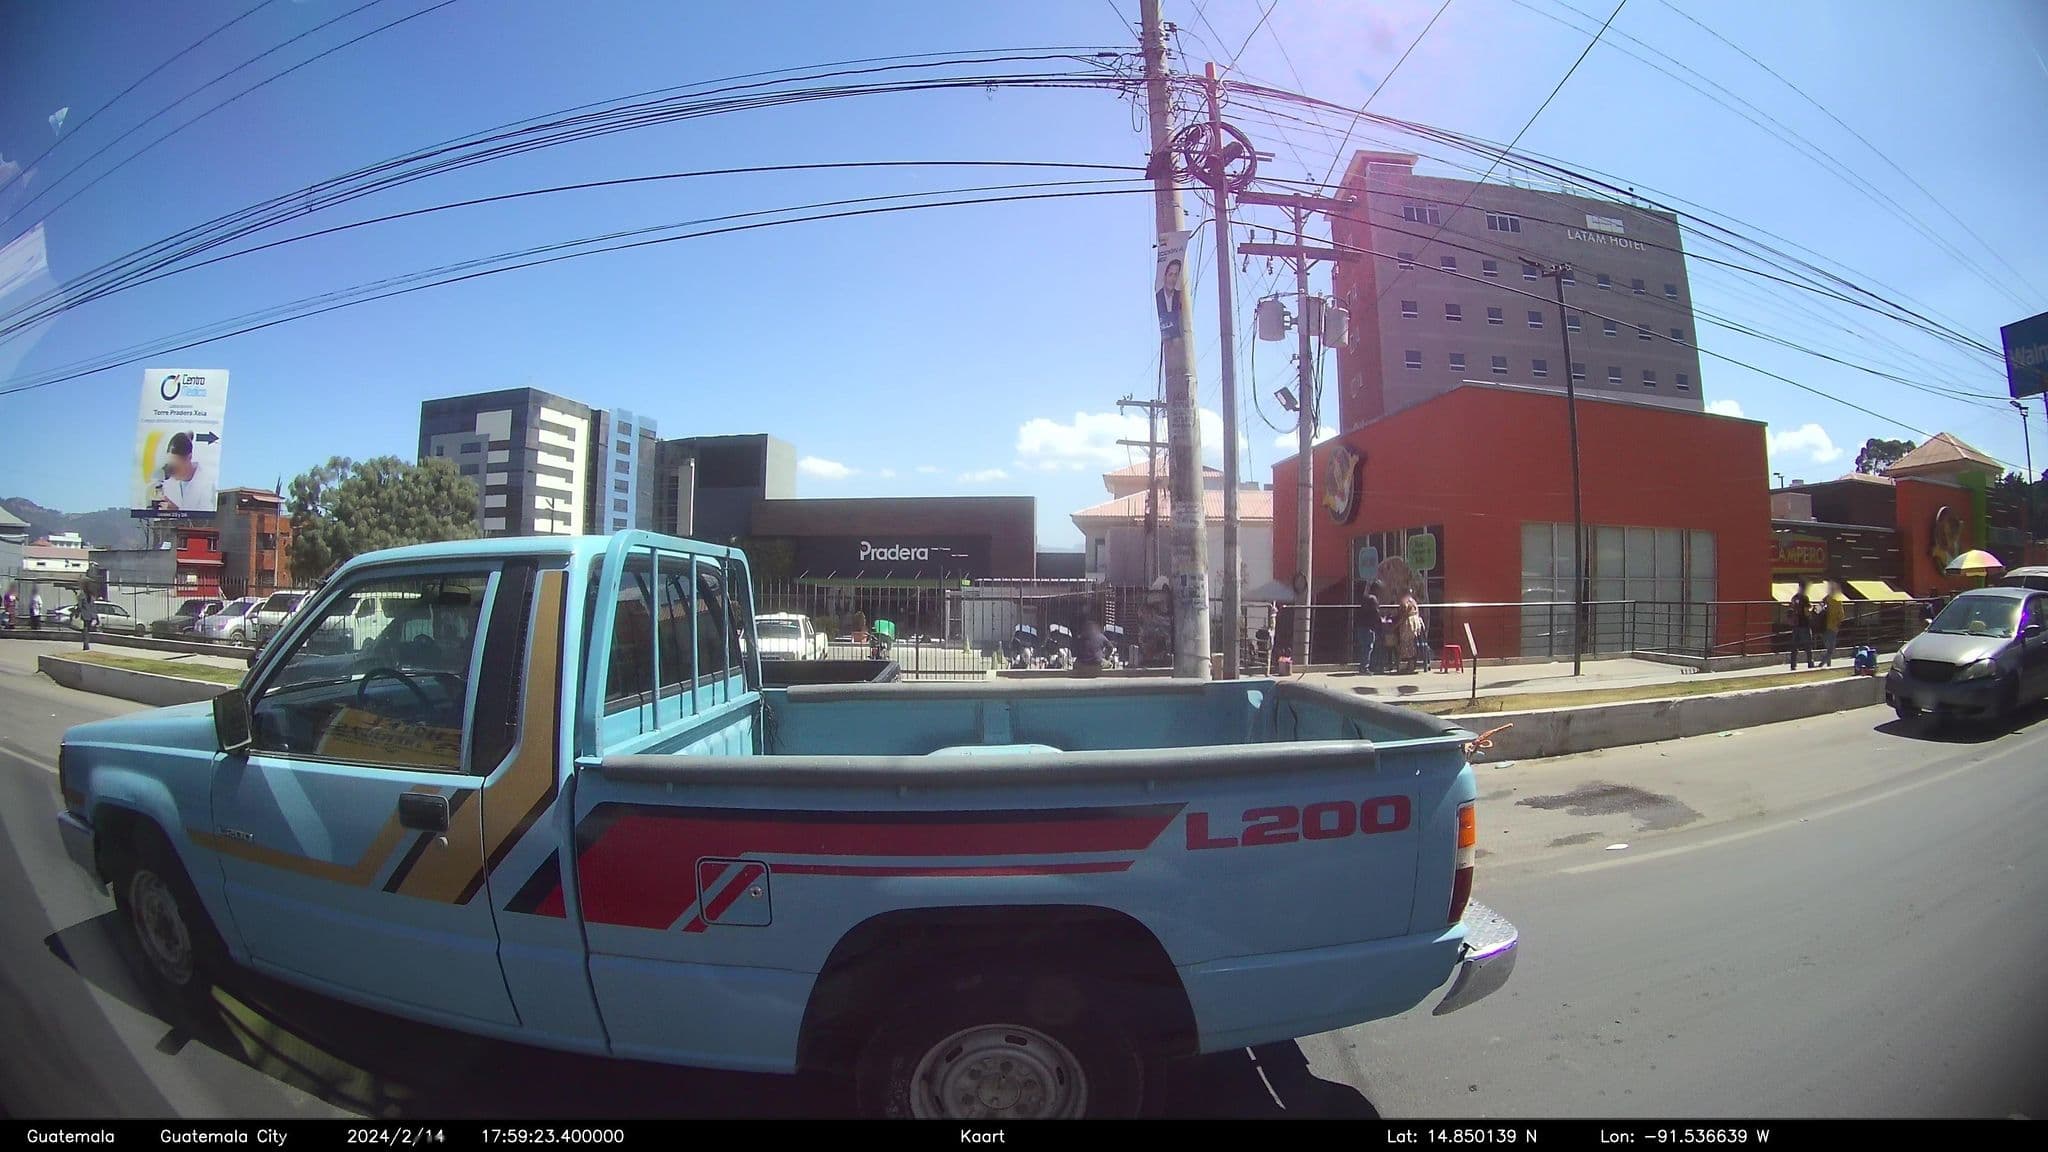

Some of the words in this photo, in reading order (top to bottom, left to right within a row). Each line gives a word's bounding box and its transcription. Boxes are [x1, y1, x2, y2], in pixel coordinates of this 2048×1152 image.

[1567, 229, 1607, 244] LATAM
[1609, 235, 1647, 251] HOTEL
[182, 373, 206, 385] Centro
[860, 541, 929, 561] Pradera
[1186, 795, 1411, 850] L200
